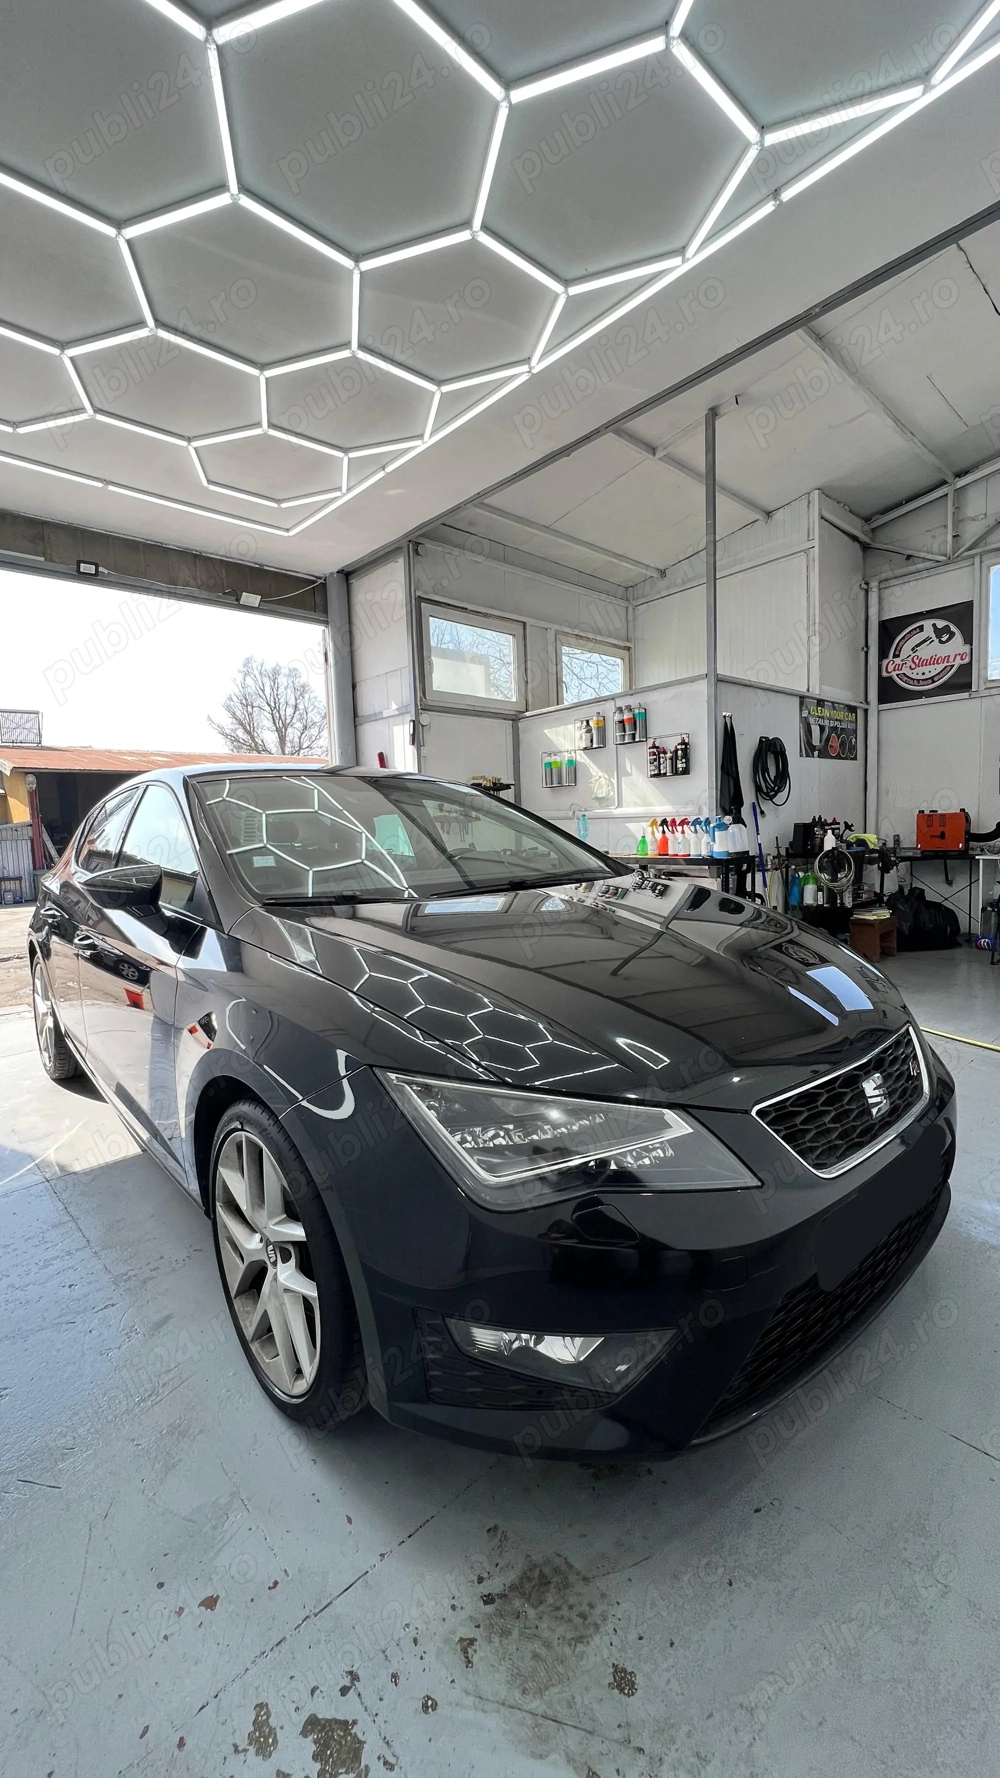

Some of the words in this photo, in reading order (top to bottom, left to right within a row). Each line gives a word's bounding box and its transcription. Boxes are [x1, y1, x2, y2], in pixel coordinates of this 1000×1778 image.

[884, 651, 968, 675] Car-Station.ro
[810, 706, 830, 718] CLEAN
[830, 709, 845, 720] YOUR
[844, 712, 856, 722] CAR
